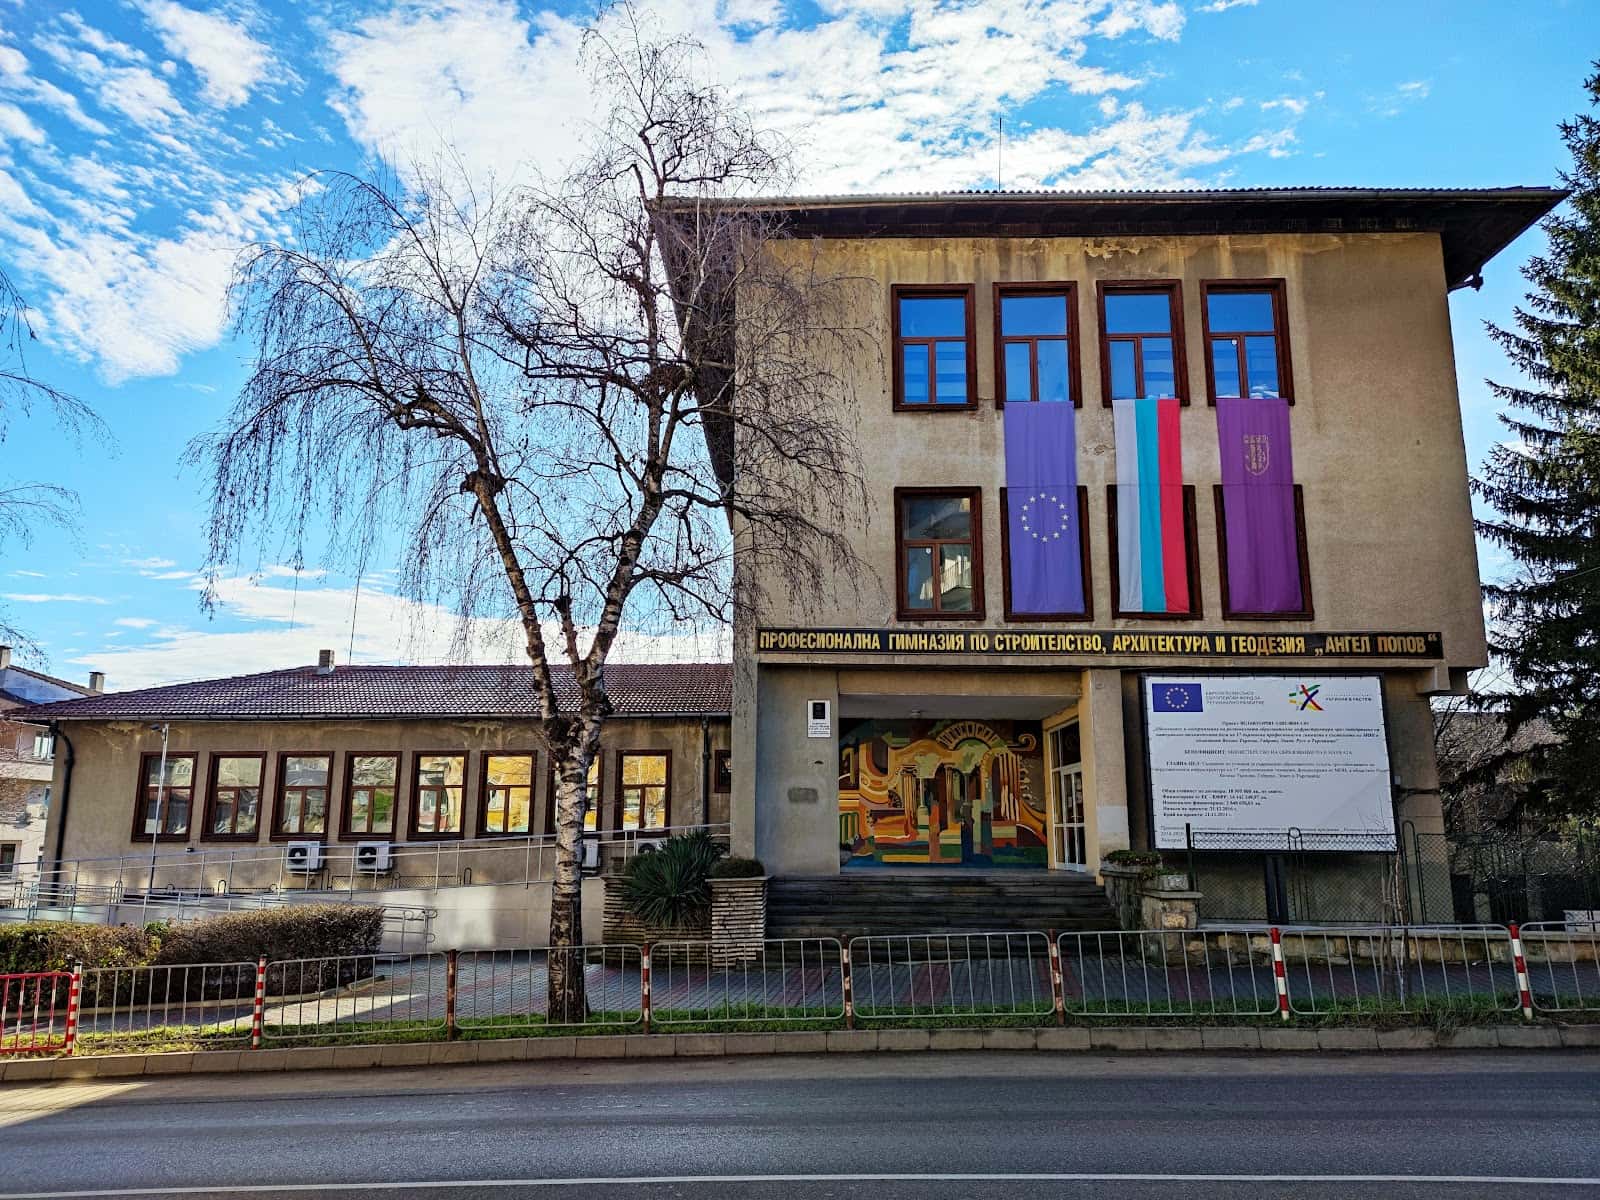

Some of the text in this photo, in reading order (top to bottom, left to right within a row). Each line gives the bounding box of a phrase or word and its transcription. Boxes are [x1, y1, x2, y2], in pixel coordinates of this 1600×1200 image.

[759, 631, 880, 649] ПРОФЕСИОНАЛНА
[888, 632, 965, 650] ГИМНАЗИЯ
[970, 633, 989, 650] ПО
[994, 633, 1107, 654] СТРОИТЕЛСТВО,
[1112, 634, 1211, 652] АРХИТЕКТУРА
[1215, 635, 1226, 653] И
[1231, 635, 1305, 656] ГЕОДЕЗИЯ
